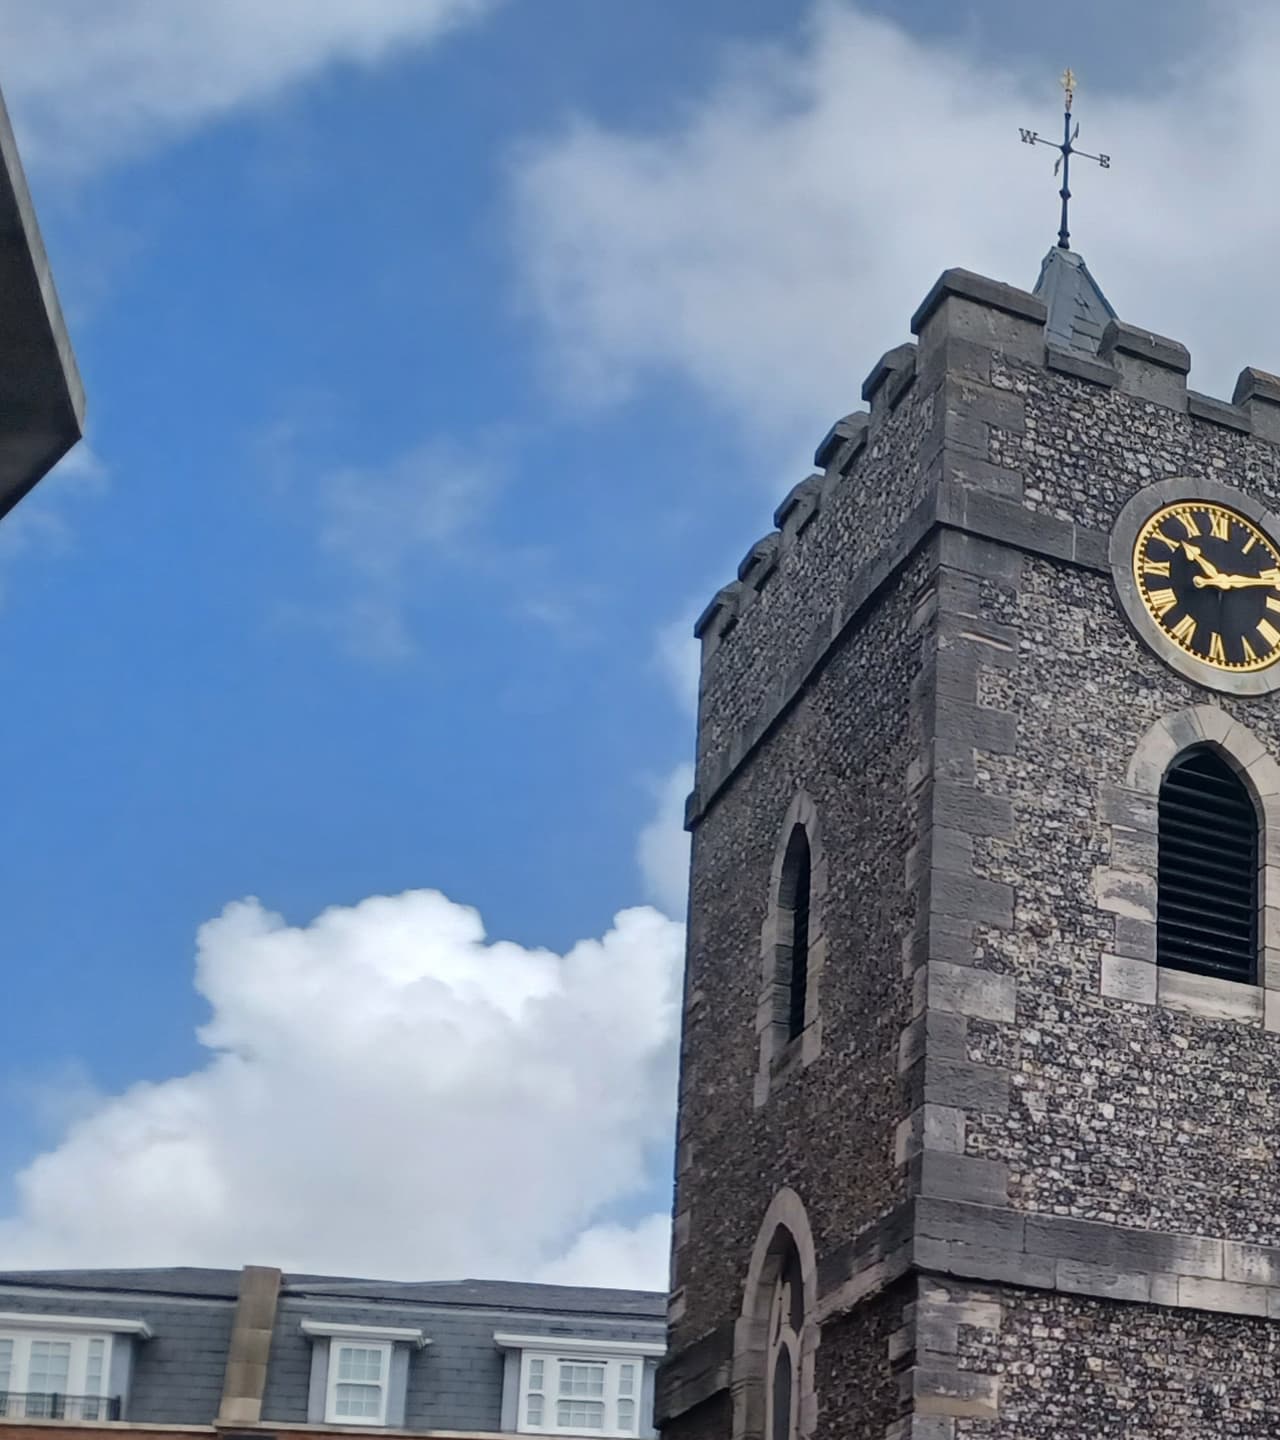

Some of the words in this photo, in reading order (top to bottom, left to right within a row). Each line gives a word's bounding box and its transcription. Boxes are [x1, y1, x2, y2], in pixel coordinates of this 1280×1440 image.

[1099, 154, 1110, 169] E
[1174, 512, 1201, 538] XI
[1208, 512, 1230, 542] XII
